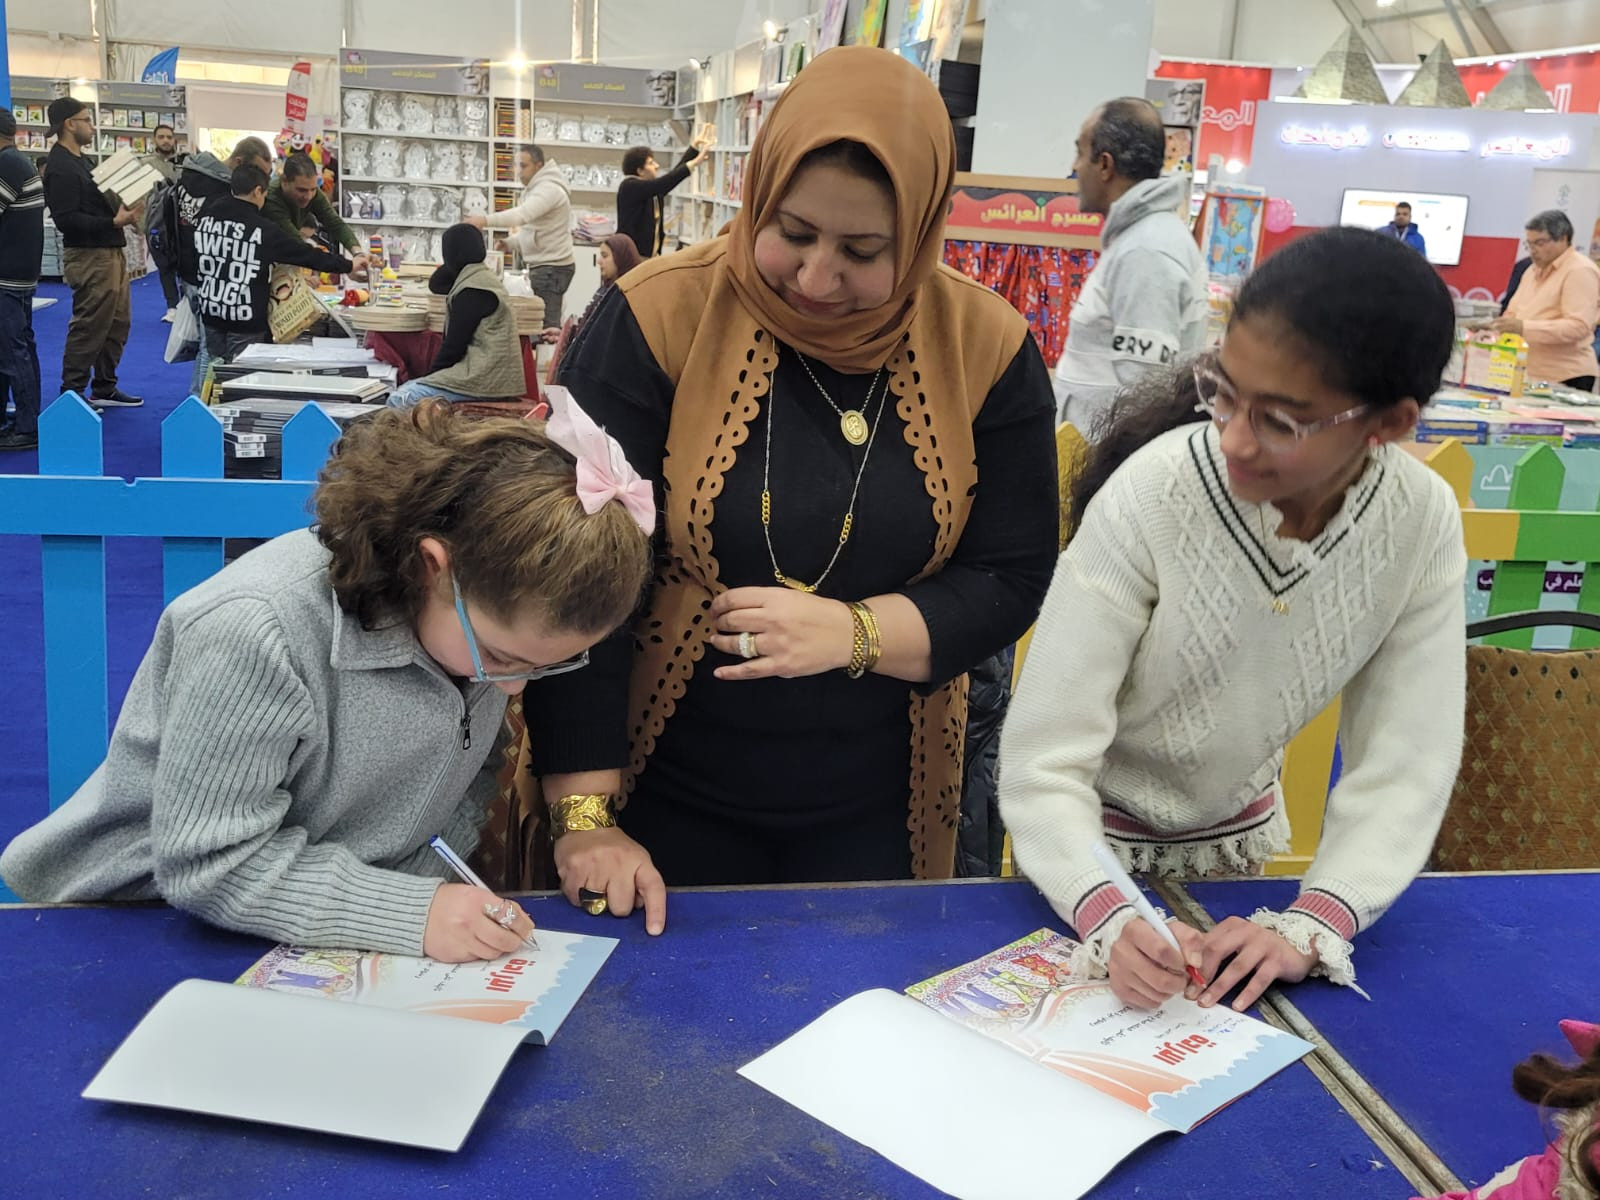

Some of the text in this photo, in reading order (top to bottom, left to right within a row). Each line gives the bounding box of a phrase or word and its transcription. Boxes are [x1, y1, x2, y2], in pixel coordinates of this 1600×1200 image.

[196, 215, 262, 245] THAT'S A
[980, 203, 1100, 227] مسرح العرائس
[194, 230, 261, 265] AWFUL
[197, 254, 260, 285] OT OF
[199, 275, 252, 306] OUGH
[485, 958, 536, 992] الإرادة
[1152, 1033, 1217, 1066] الإرادة
